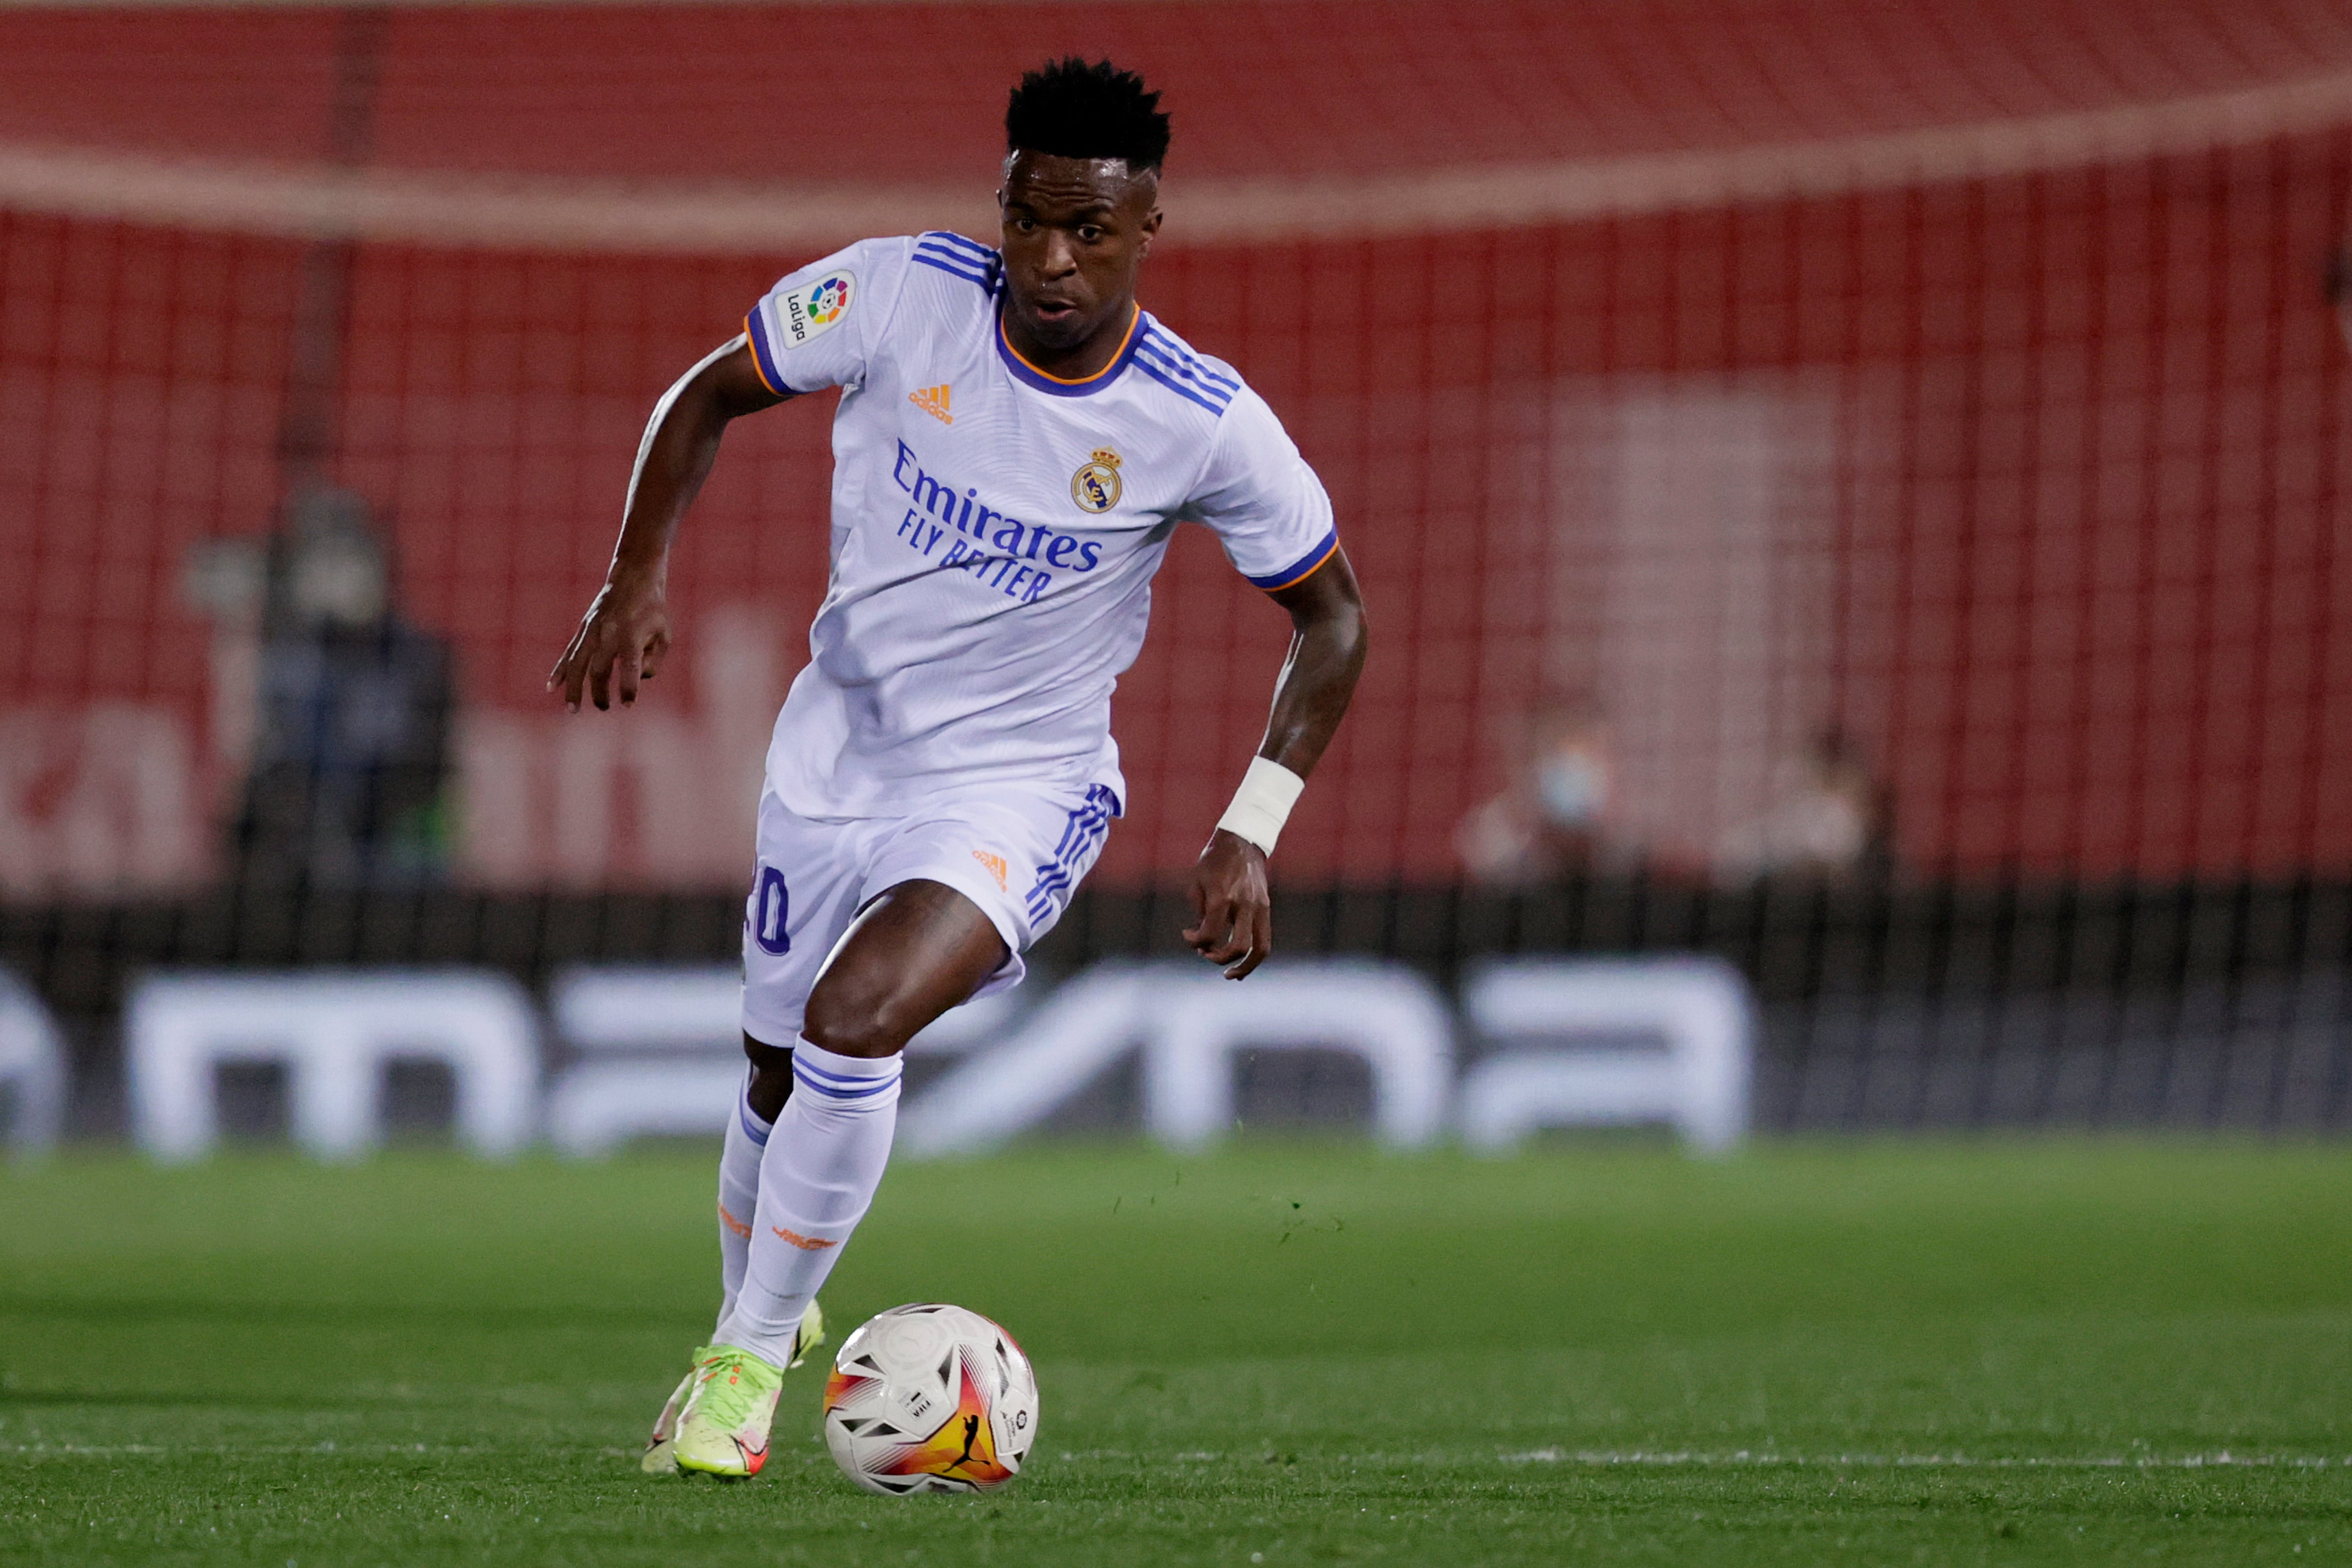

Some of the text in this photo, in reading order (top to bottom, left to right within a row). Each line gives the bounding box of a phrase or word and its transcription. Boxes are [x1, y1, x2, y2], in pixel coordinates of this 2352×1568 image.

[788, 293, 806, 341] LaLiga
[908, 392, 954, 425] adidas
[893, 437, 1102, 572] Emirates
[897, 508, 1052, 602] FLY BETTER
